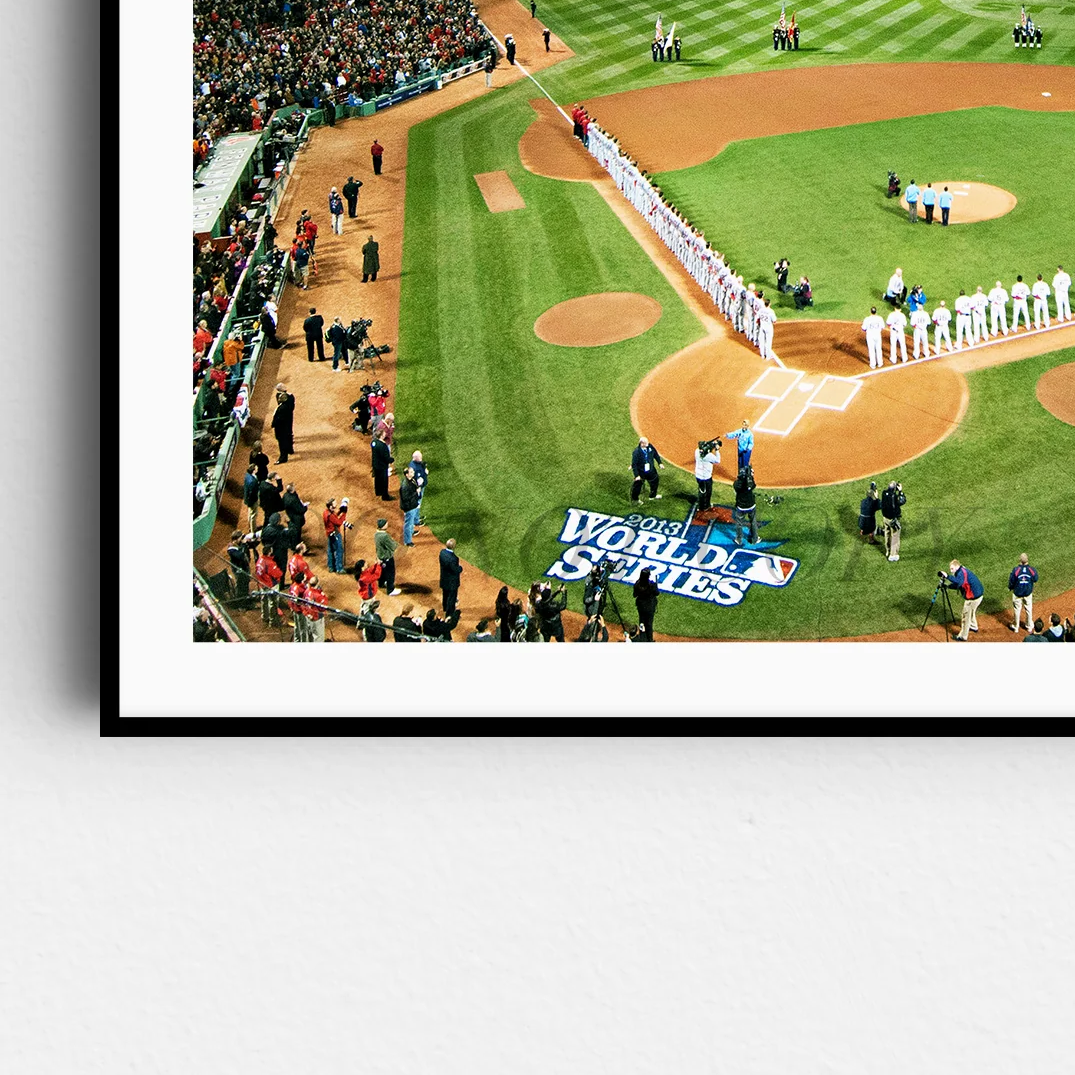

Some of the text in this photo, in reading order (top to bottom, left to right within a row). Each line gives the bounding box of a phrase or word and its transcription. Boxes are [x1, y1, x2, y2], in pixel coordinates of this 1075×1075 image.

[560, 507, 730, 572] WORLD
[622, 513, 684, 537] 2013
[546, 544, 751, 607] SERIES
